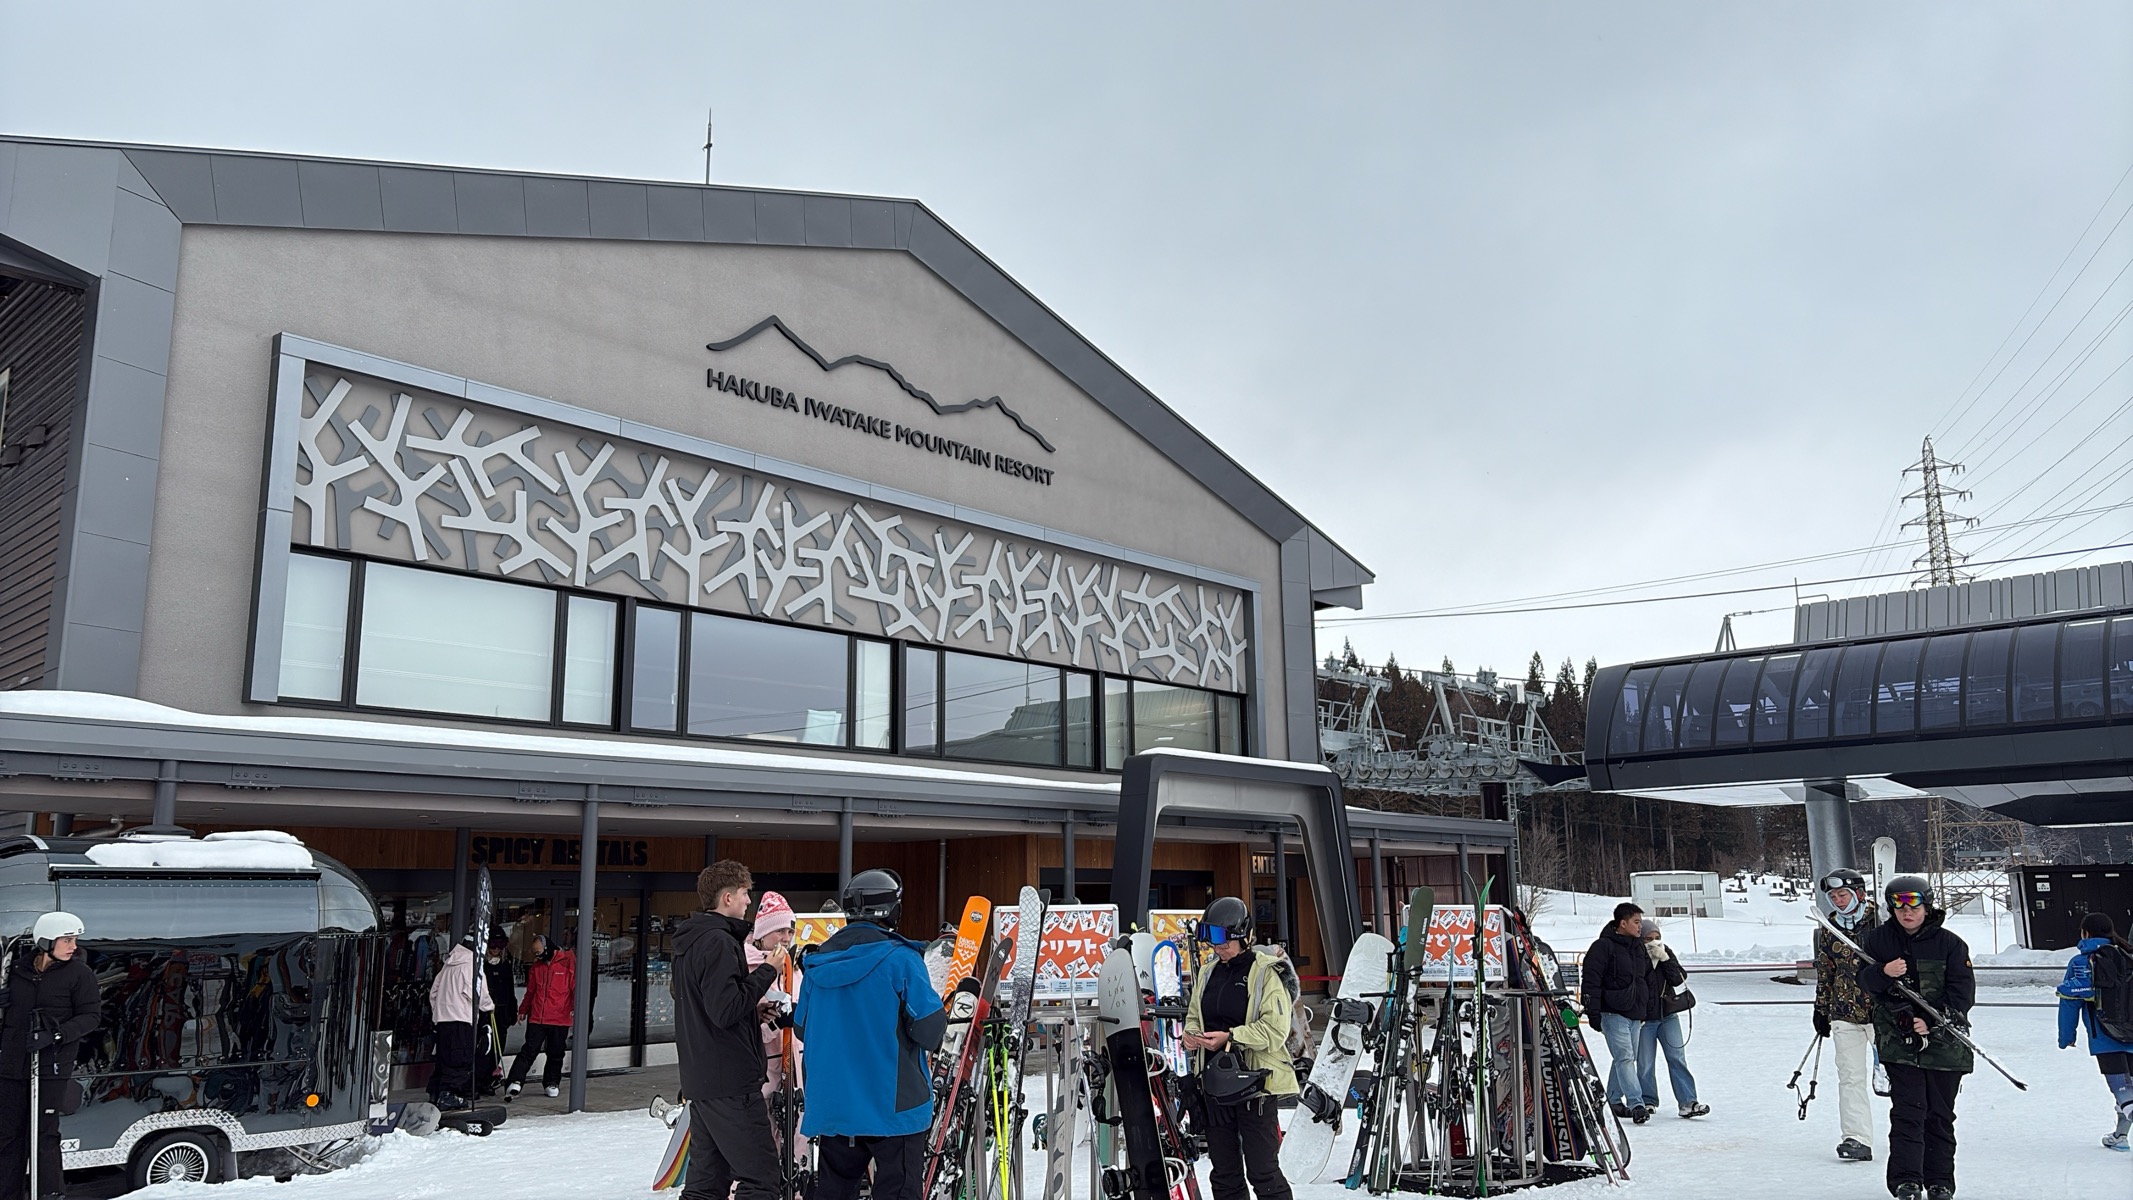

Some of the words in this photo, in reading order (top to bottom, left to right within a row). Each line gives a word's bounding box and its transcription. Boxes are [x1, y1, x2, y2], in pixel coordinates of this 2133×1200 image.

[707, 368, 799, 413] HAKUBA
[804, 396, 891, 439] IWATAKE
[895, 424, 991, 468] MOUNTAIN
[995, 454, 1054, 486] RESORT
[472, 836, 545, 864] SPICY
[552, 839, 648, 866] RETALS
